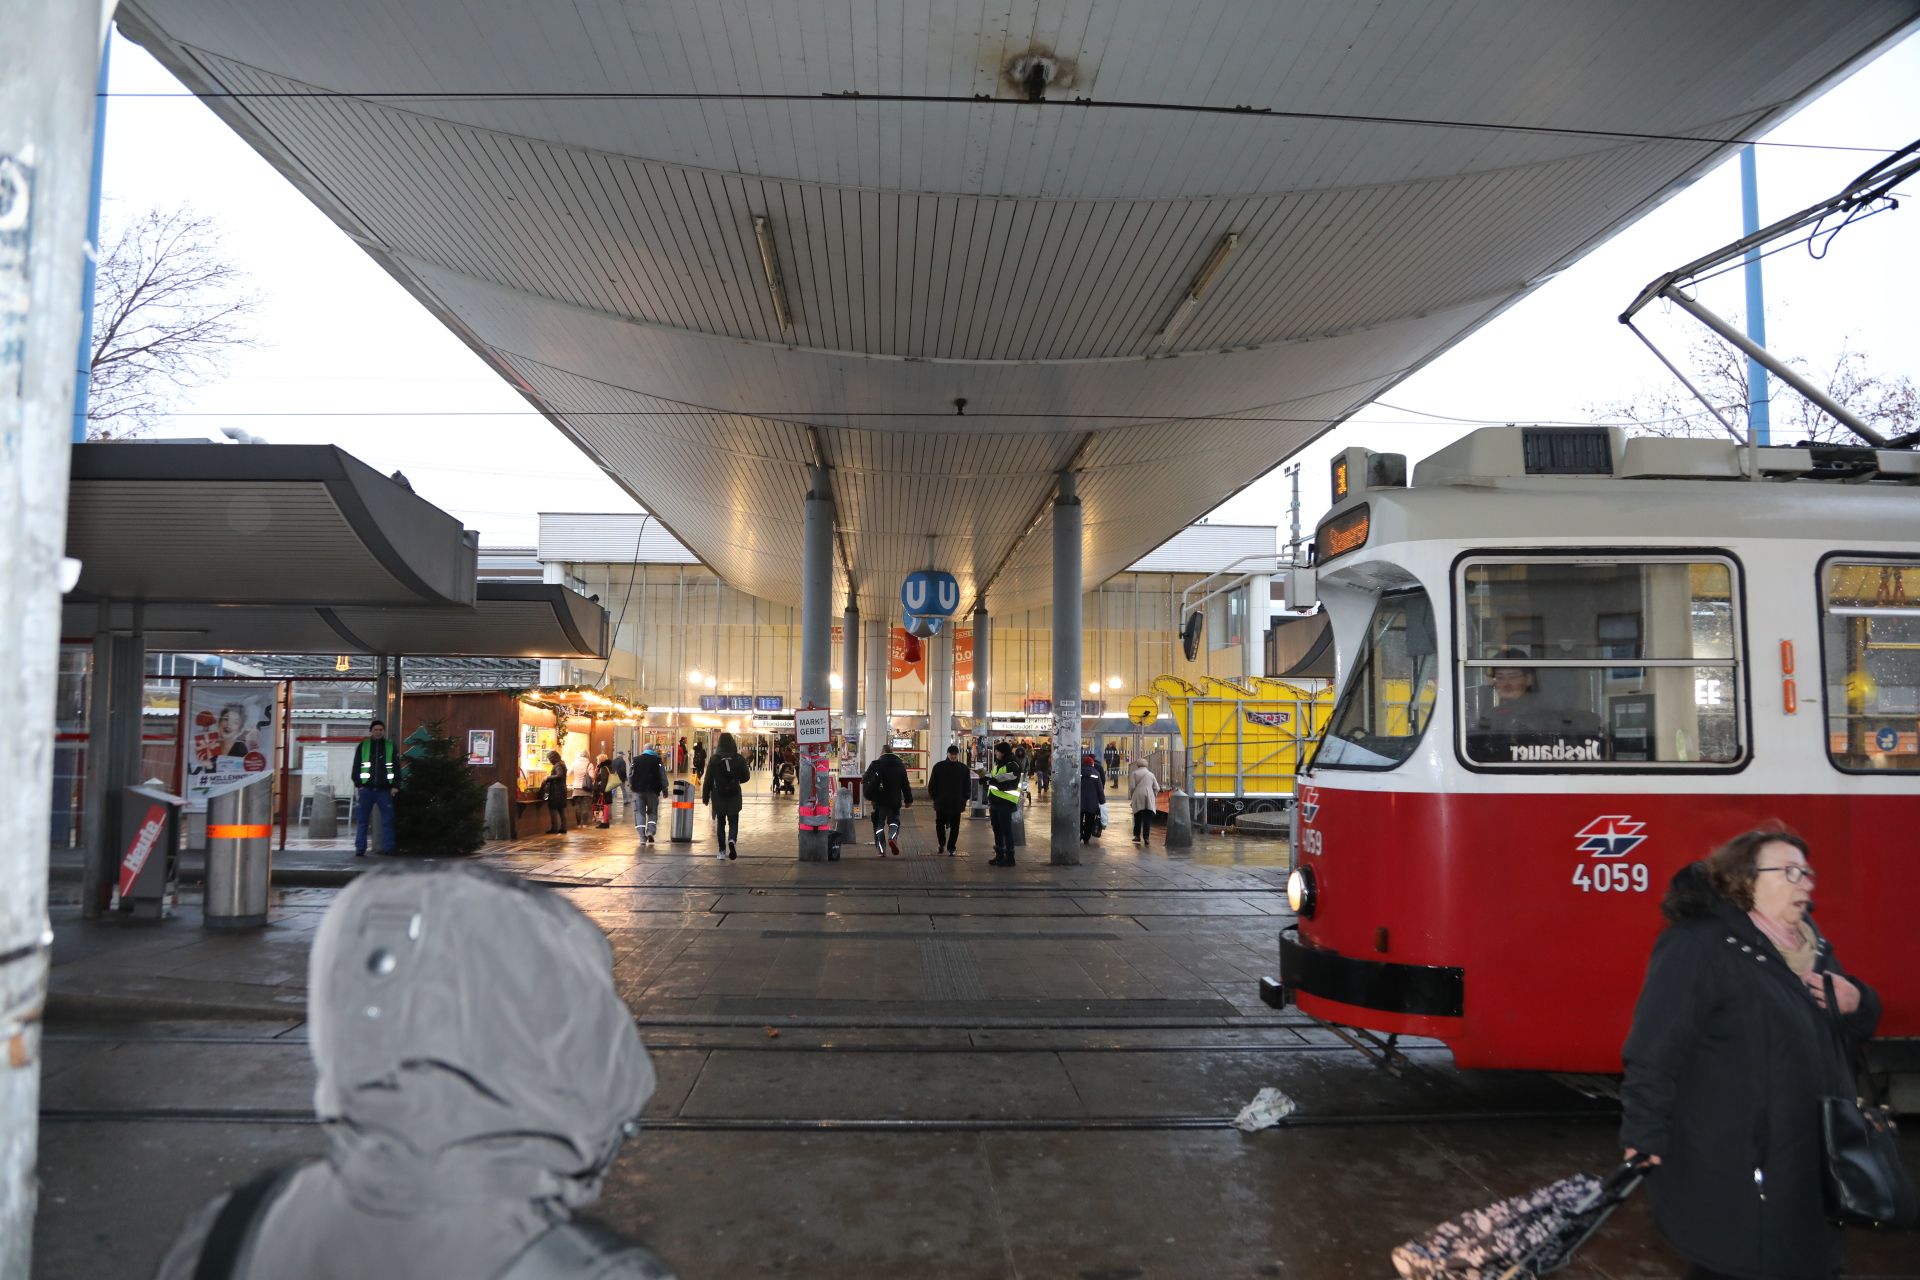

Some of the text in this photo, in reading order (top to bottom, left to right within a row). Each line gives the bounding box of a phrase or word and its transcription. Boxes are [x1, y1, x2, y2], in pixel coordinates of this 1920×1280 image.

[906, 580, 956, 609] U U
[799, 718, 826, 726] MARKT-
[800, 727, 825, 735] GEBIET
[123, 820, 160, 874] Heute
[1572, 863, 1648, 893] 4059
